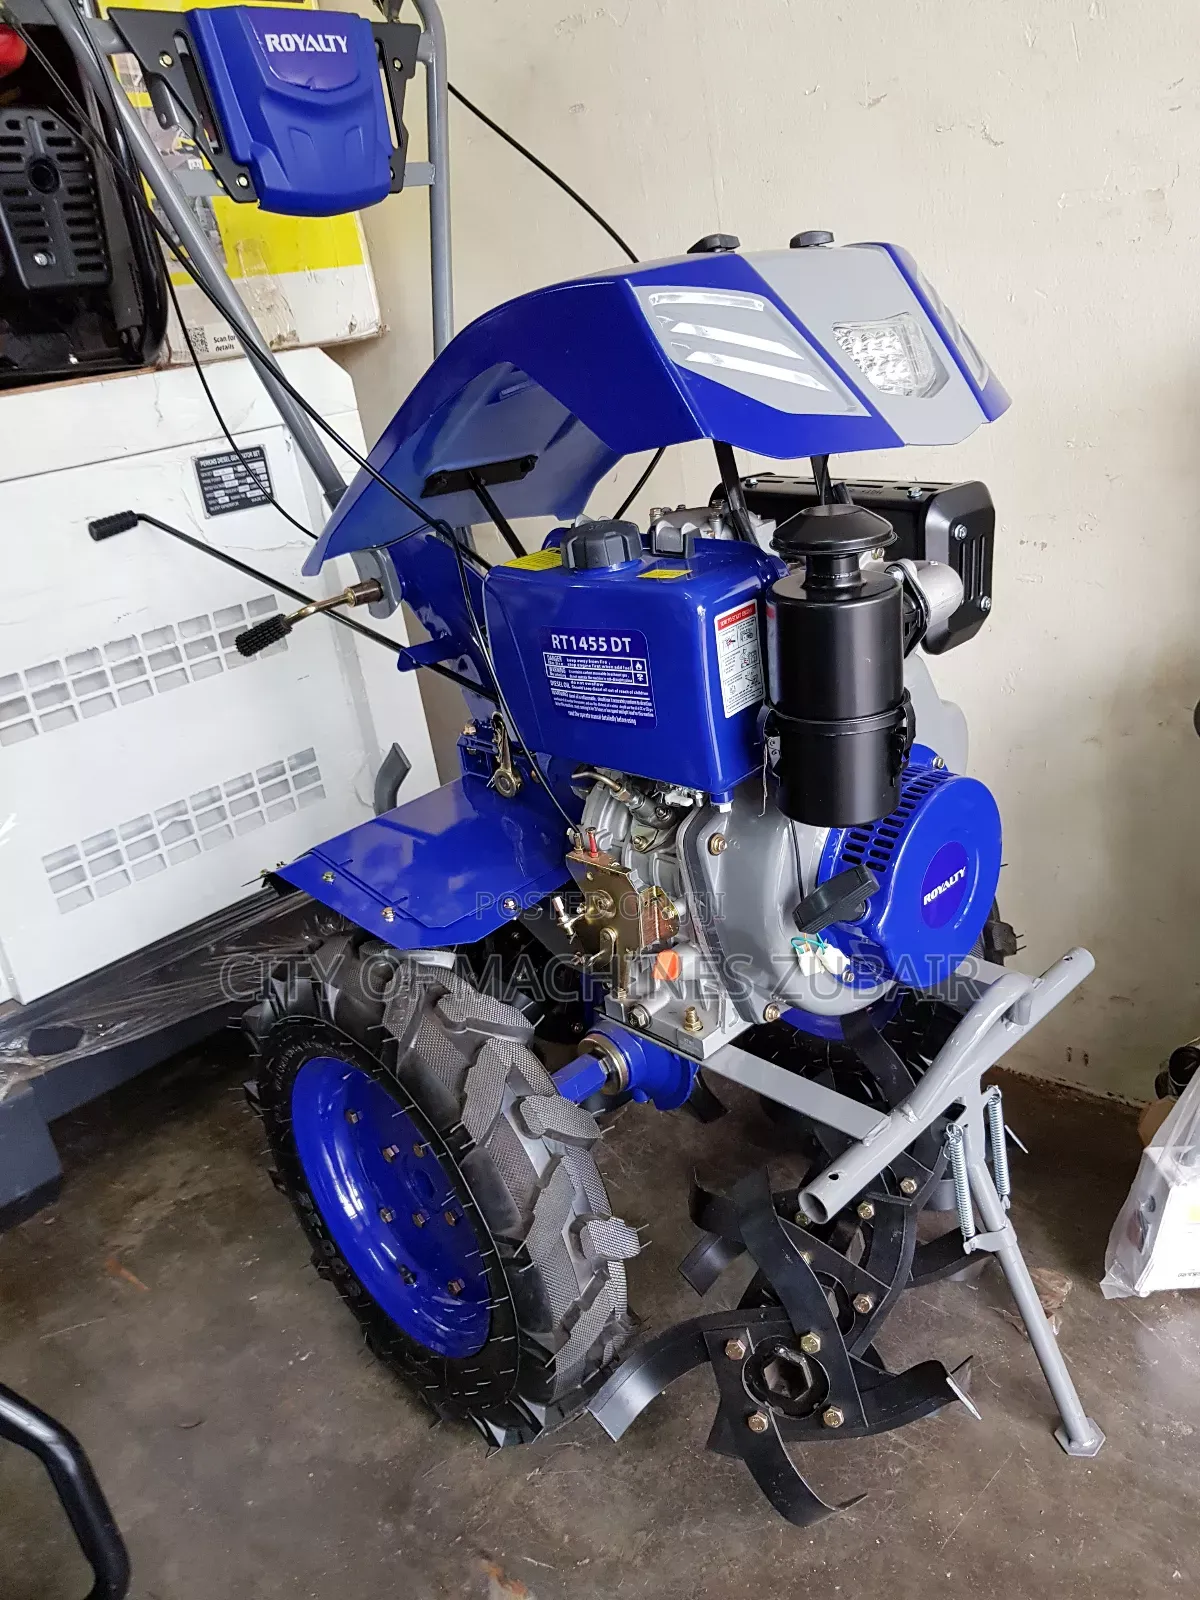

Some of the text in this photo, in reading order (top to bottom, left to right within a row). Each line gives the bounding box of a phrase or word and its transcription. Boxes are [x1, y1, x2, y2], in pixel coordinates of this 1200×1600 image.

[264, 33, 348, 53] ROYALTY
[610, 636, 632, 653] DT
[923, 865, 967, 906] ROYALTY
